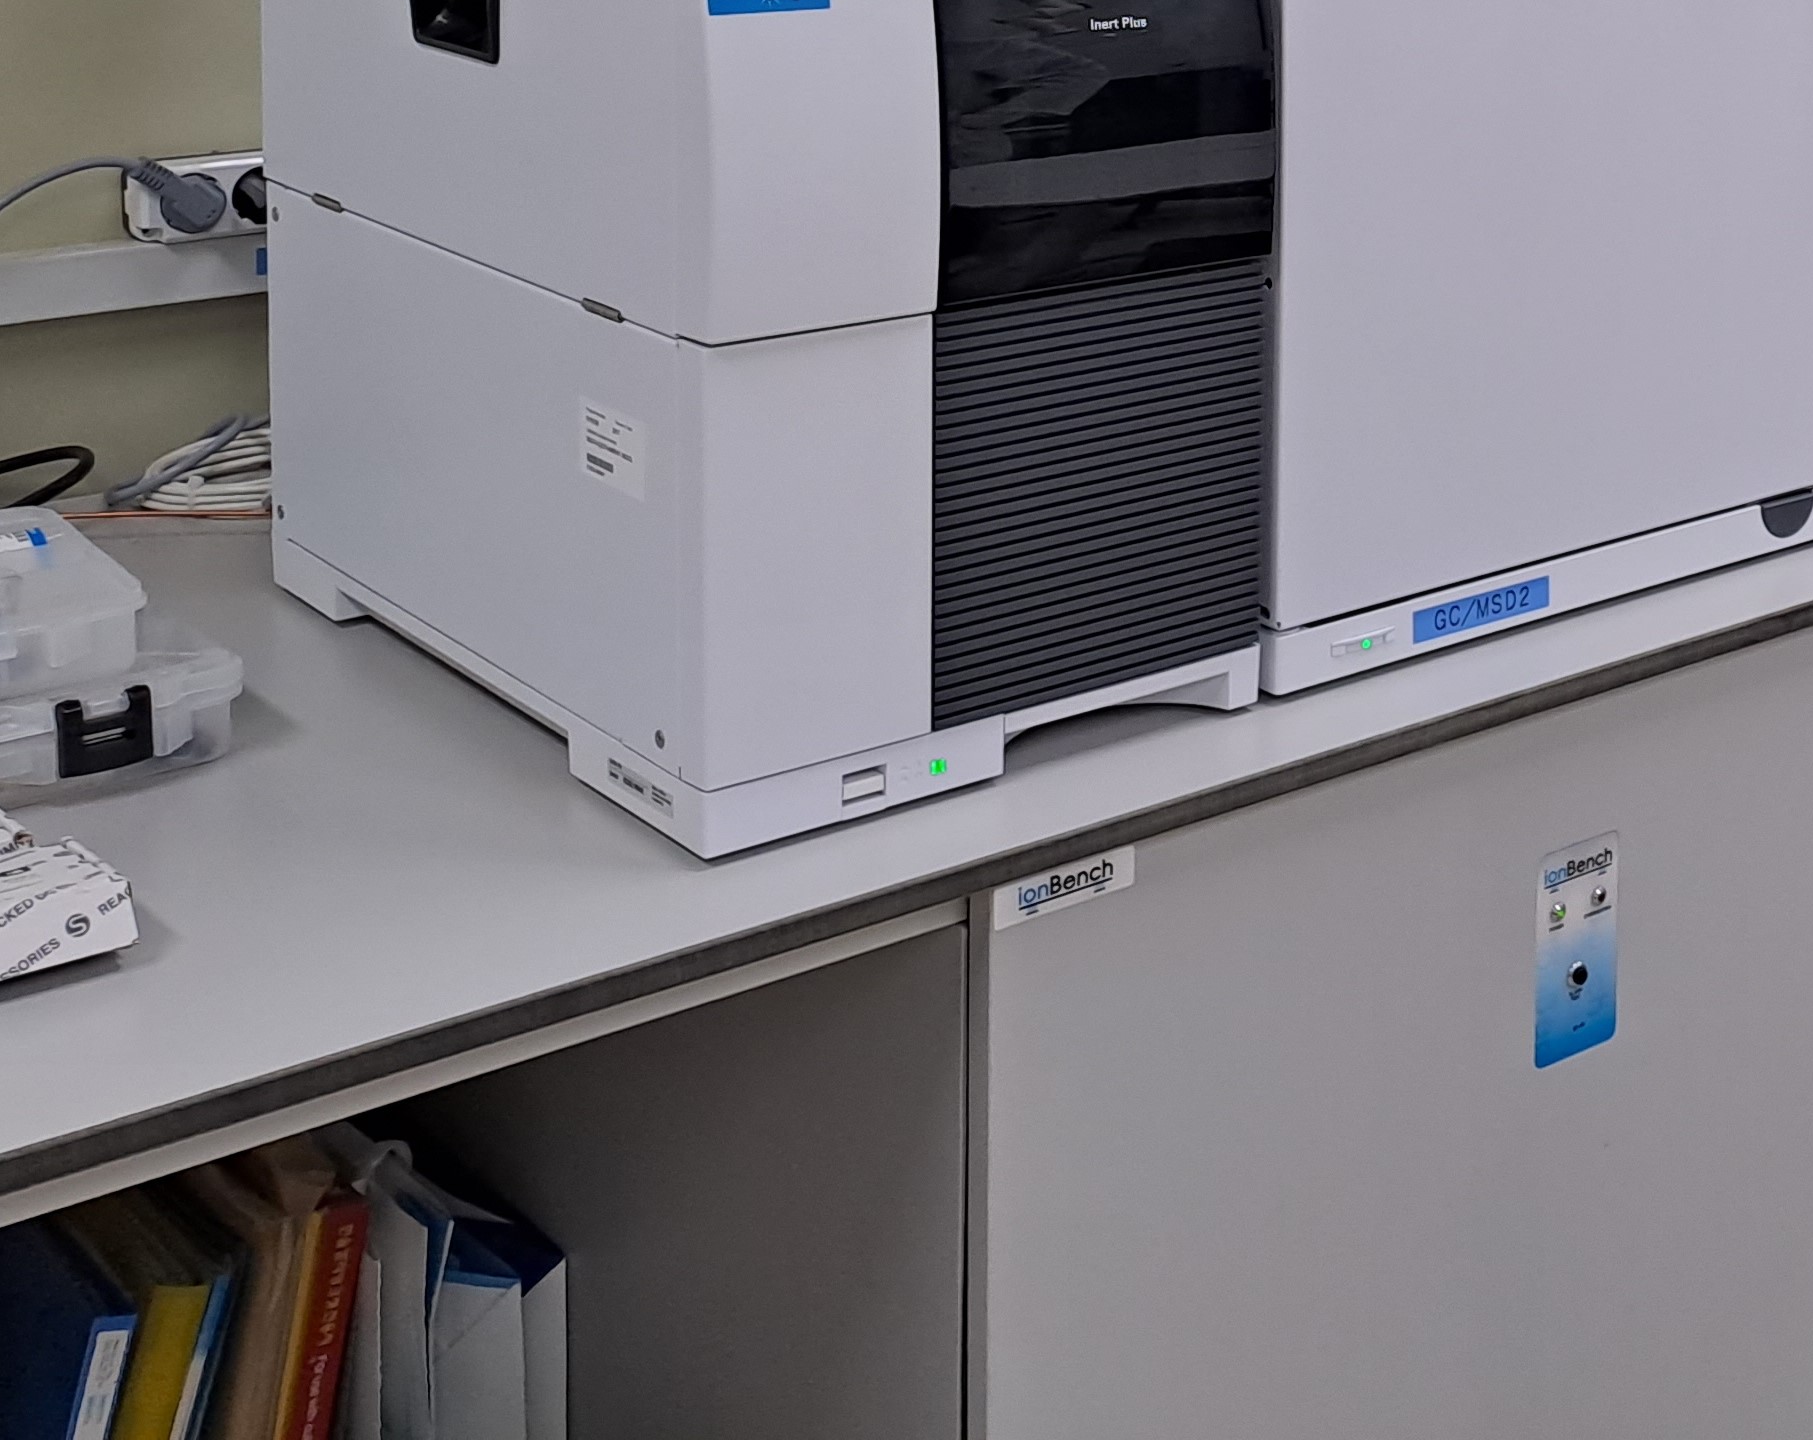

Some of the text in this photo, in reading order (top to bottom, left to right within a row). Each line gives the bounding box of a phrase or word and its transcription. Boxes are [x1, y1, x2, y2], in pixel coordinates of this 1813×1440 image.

[1090, 16, 1148, 31] Inert Plus
[1434, 586, 1530, 631] GC/MSD2
[1017, 859, 1114, 906] ionBench
[1544, 847, 1613, 886] ionBench
